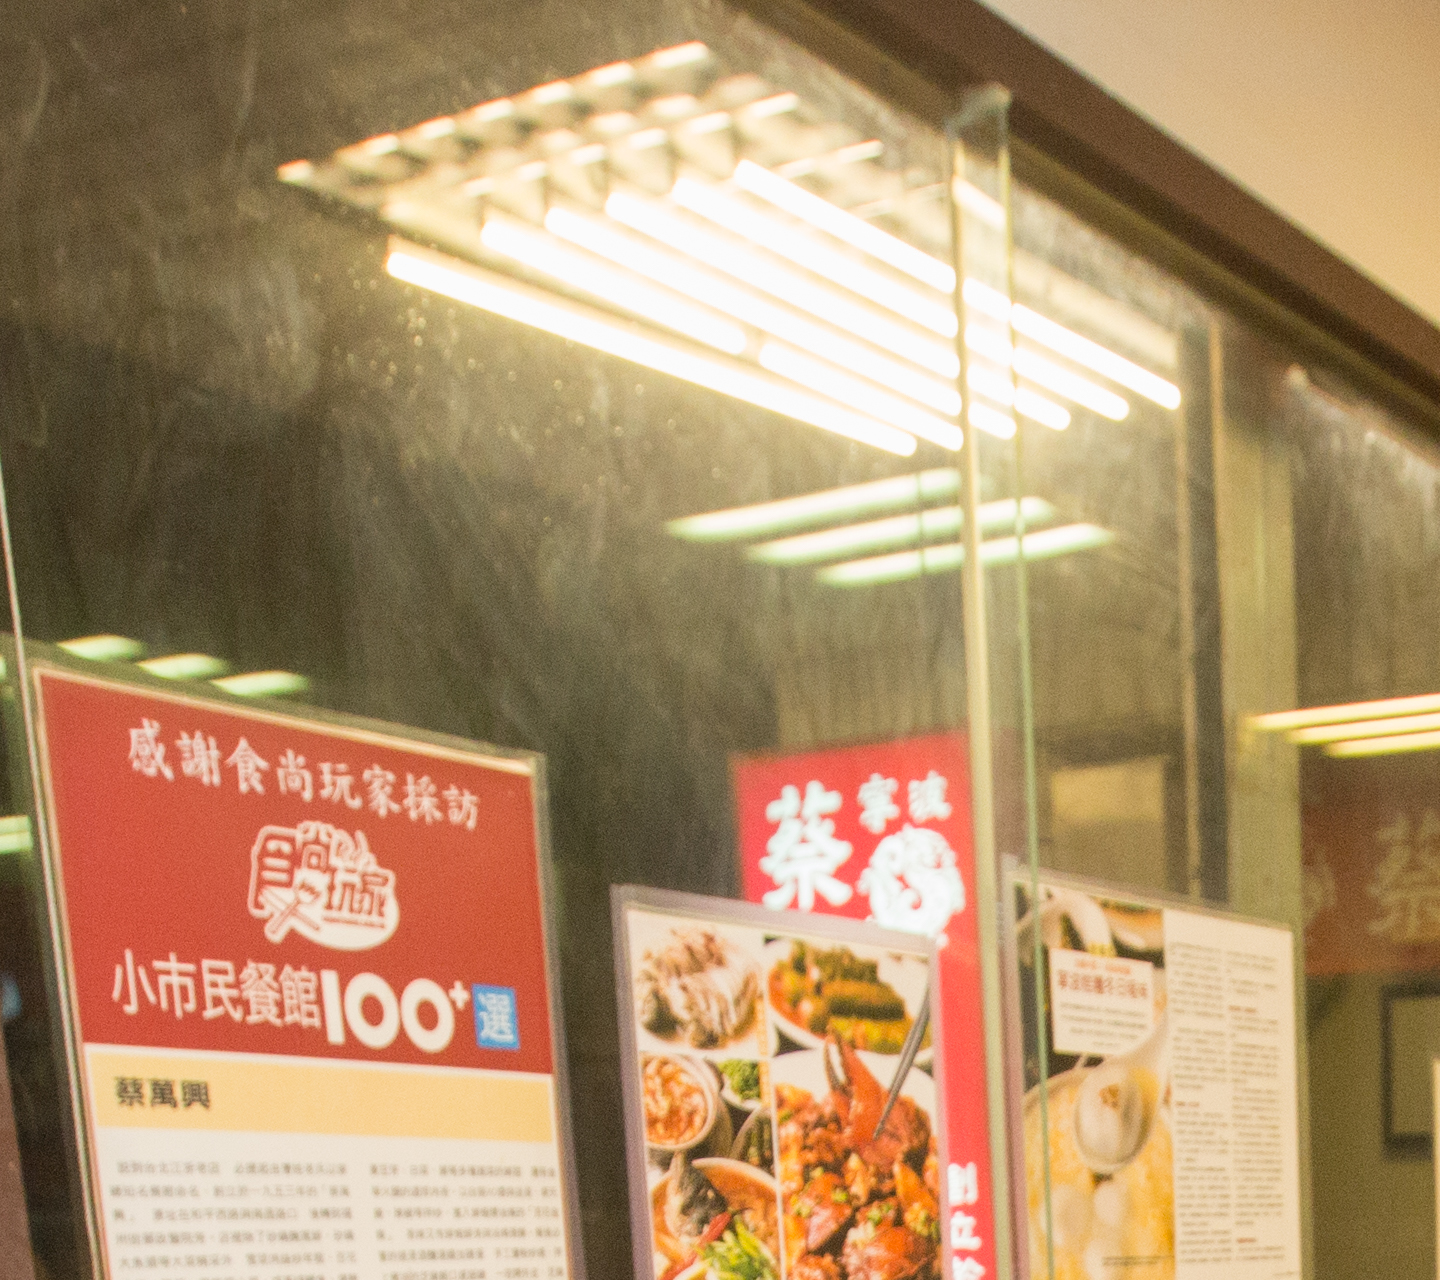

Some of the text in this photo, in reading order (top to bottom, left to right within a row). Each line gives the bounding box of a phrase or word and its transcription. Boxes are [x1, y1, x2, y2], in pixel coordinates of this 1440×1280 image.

[128, 717, 479, 829] 感謝食尚玩家採訪
[758, 779, 854, 911] 蔡
[114, 1076, 211, 1110] 蔡萬興
